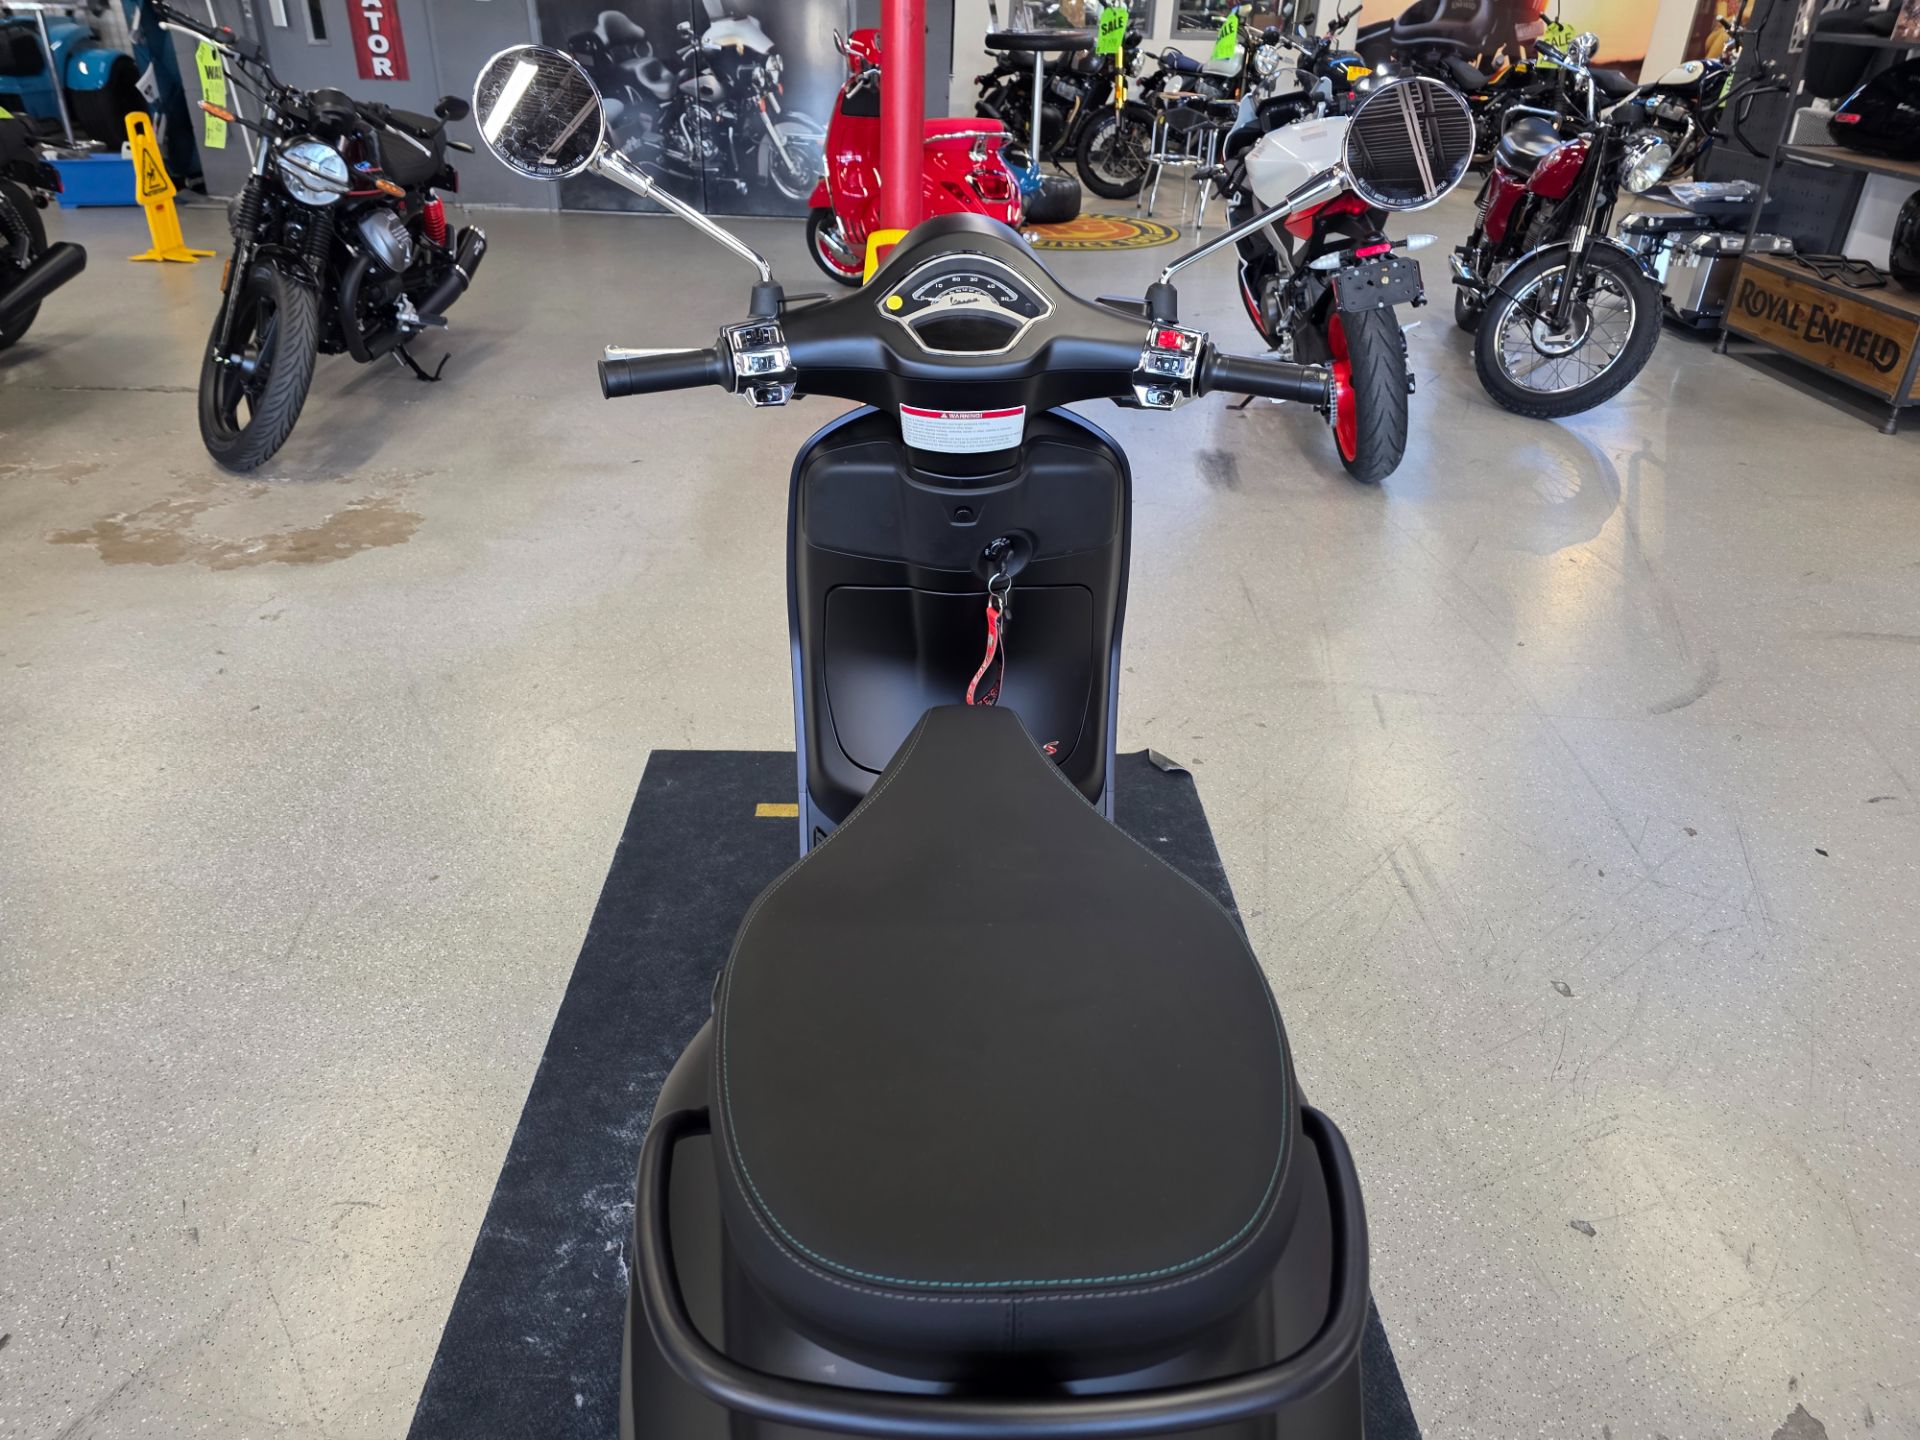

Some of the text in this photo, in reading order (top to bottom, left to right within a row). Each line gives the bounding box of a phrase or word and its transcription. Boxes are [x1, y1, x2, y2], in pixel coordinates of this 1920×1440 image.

[1101, 16, 1124, 36] SALE
[1736, 278, 1900, 373] ROYAL ENFIELD
